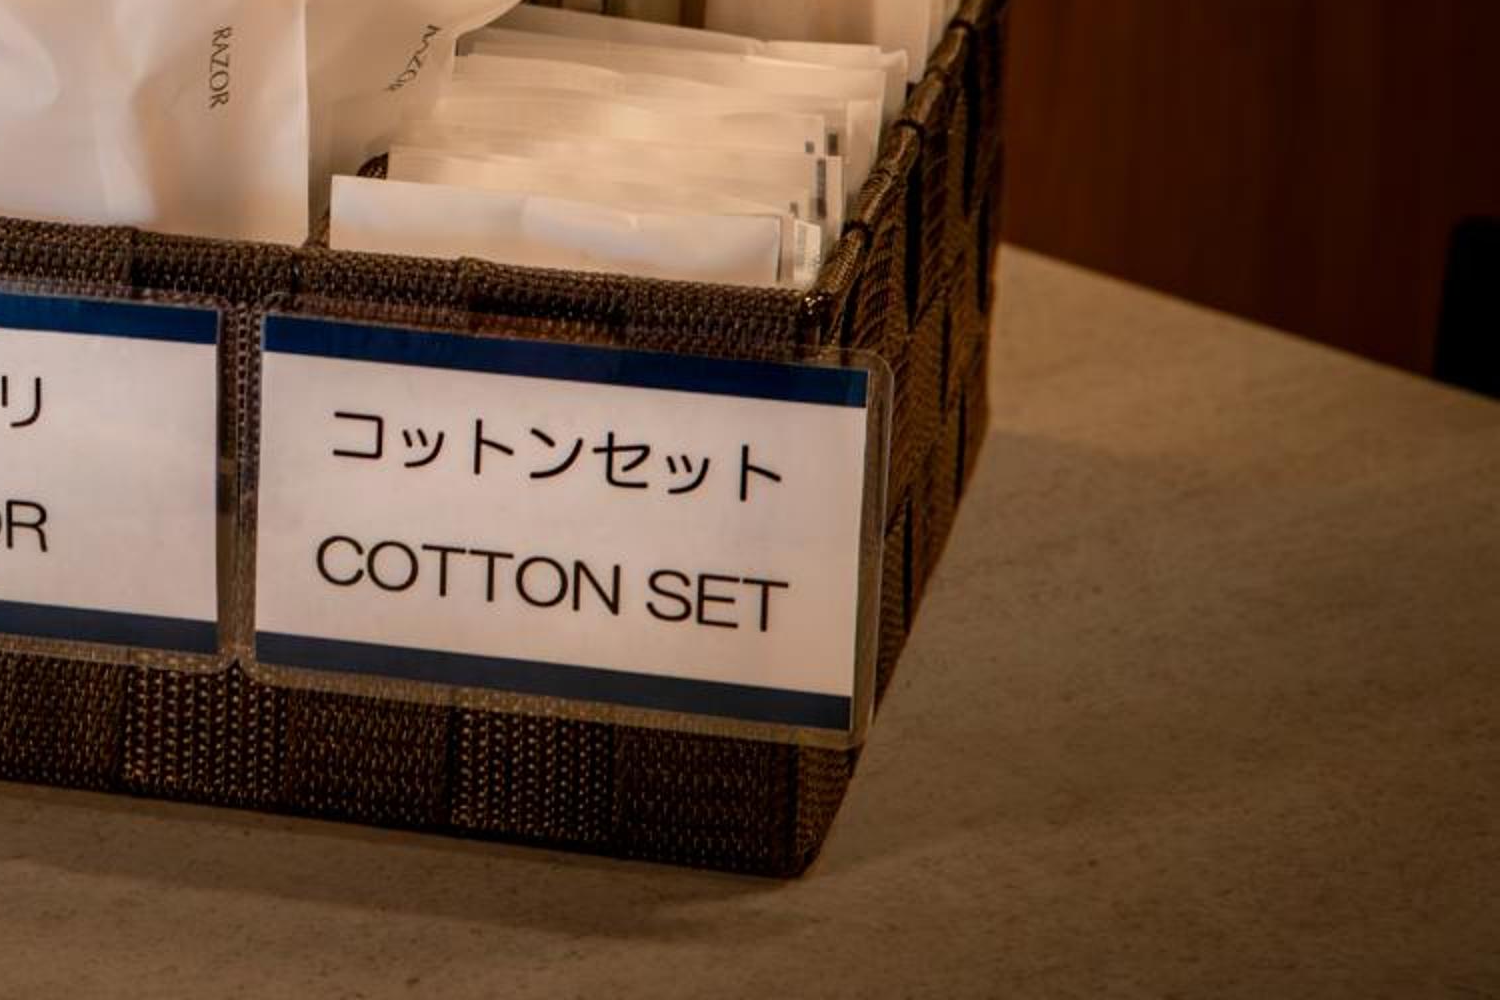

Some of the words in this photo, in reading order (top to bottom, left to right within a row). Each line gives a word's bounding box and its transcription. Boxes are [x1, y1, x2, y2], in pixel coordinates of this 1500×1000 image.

[209, 26, 232, 109] RAZOR
[333, 411, 782, 502] コットンセット
[316, 535, 620, 616] COTTON
[646, 569, 788, 633] SET
